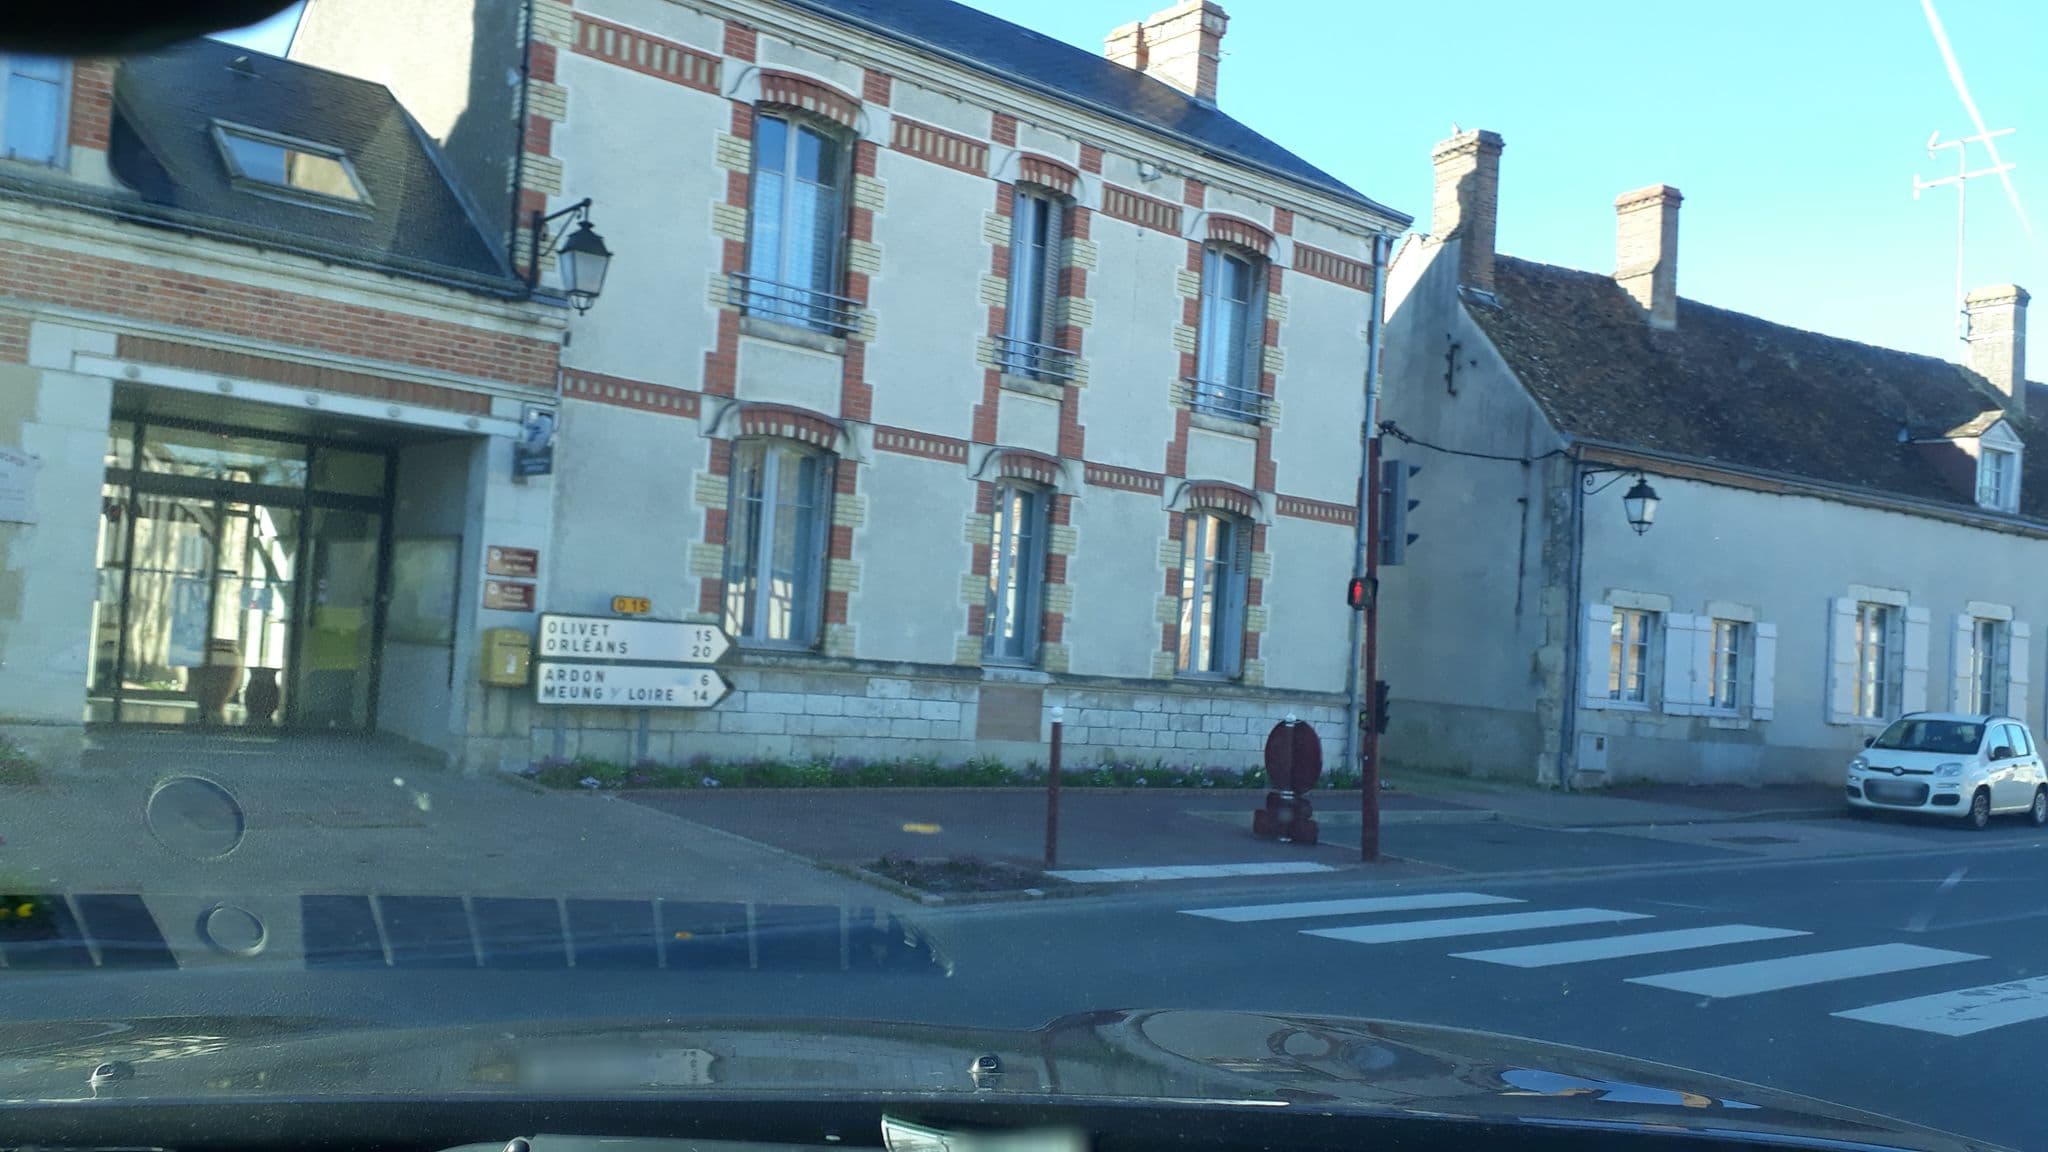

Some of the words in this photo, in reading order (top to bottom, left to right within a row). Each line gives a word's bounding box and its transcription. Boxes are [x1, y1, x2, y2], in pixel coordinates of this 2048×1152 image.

[617, 599, 625, 611] D
[632, 600, 648, 612] 15
[547, 621, 610, 637] OLIVET
[695, 630, 712, 642] 15
[546, 638, 629, 655] ORLÉANS
[692, 646, 712, 658] 20
[544, 669, 606, 683] ARDON
[700, 674, 709, 686] 6
[543, 685, 604, 699] MEUNG
[628, 688, 675, 702] LOIRE
[693, 690, 708, 702] 14
